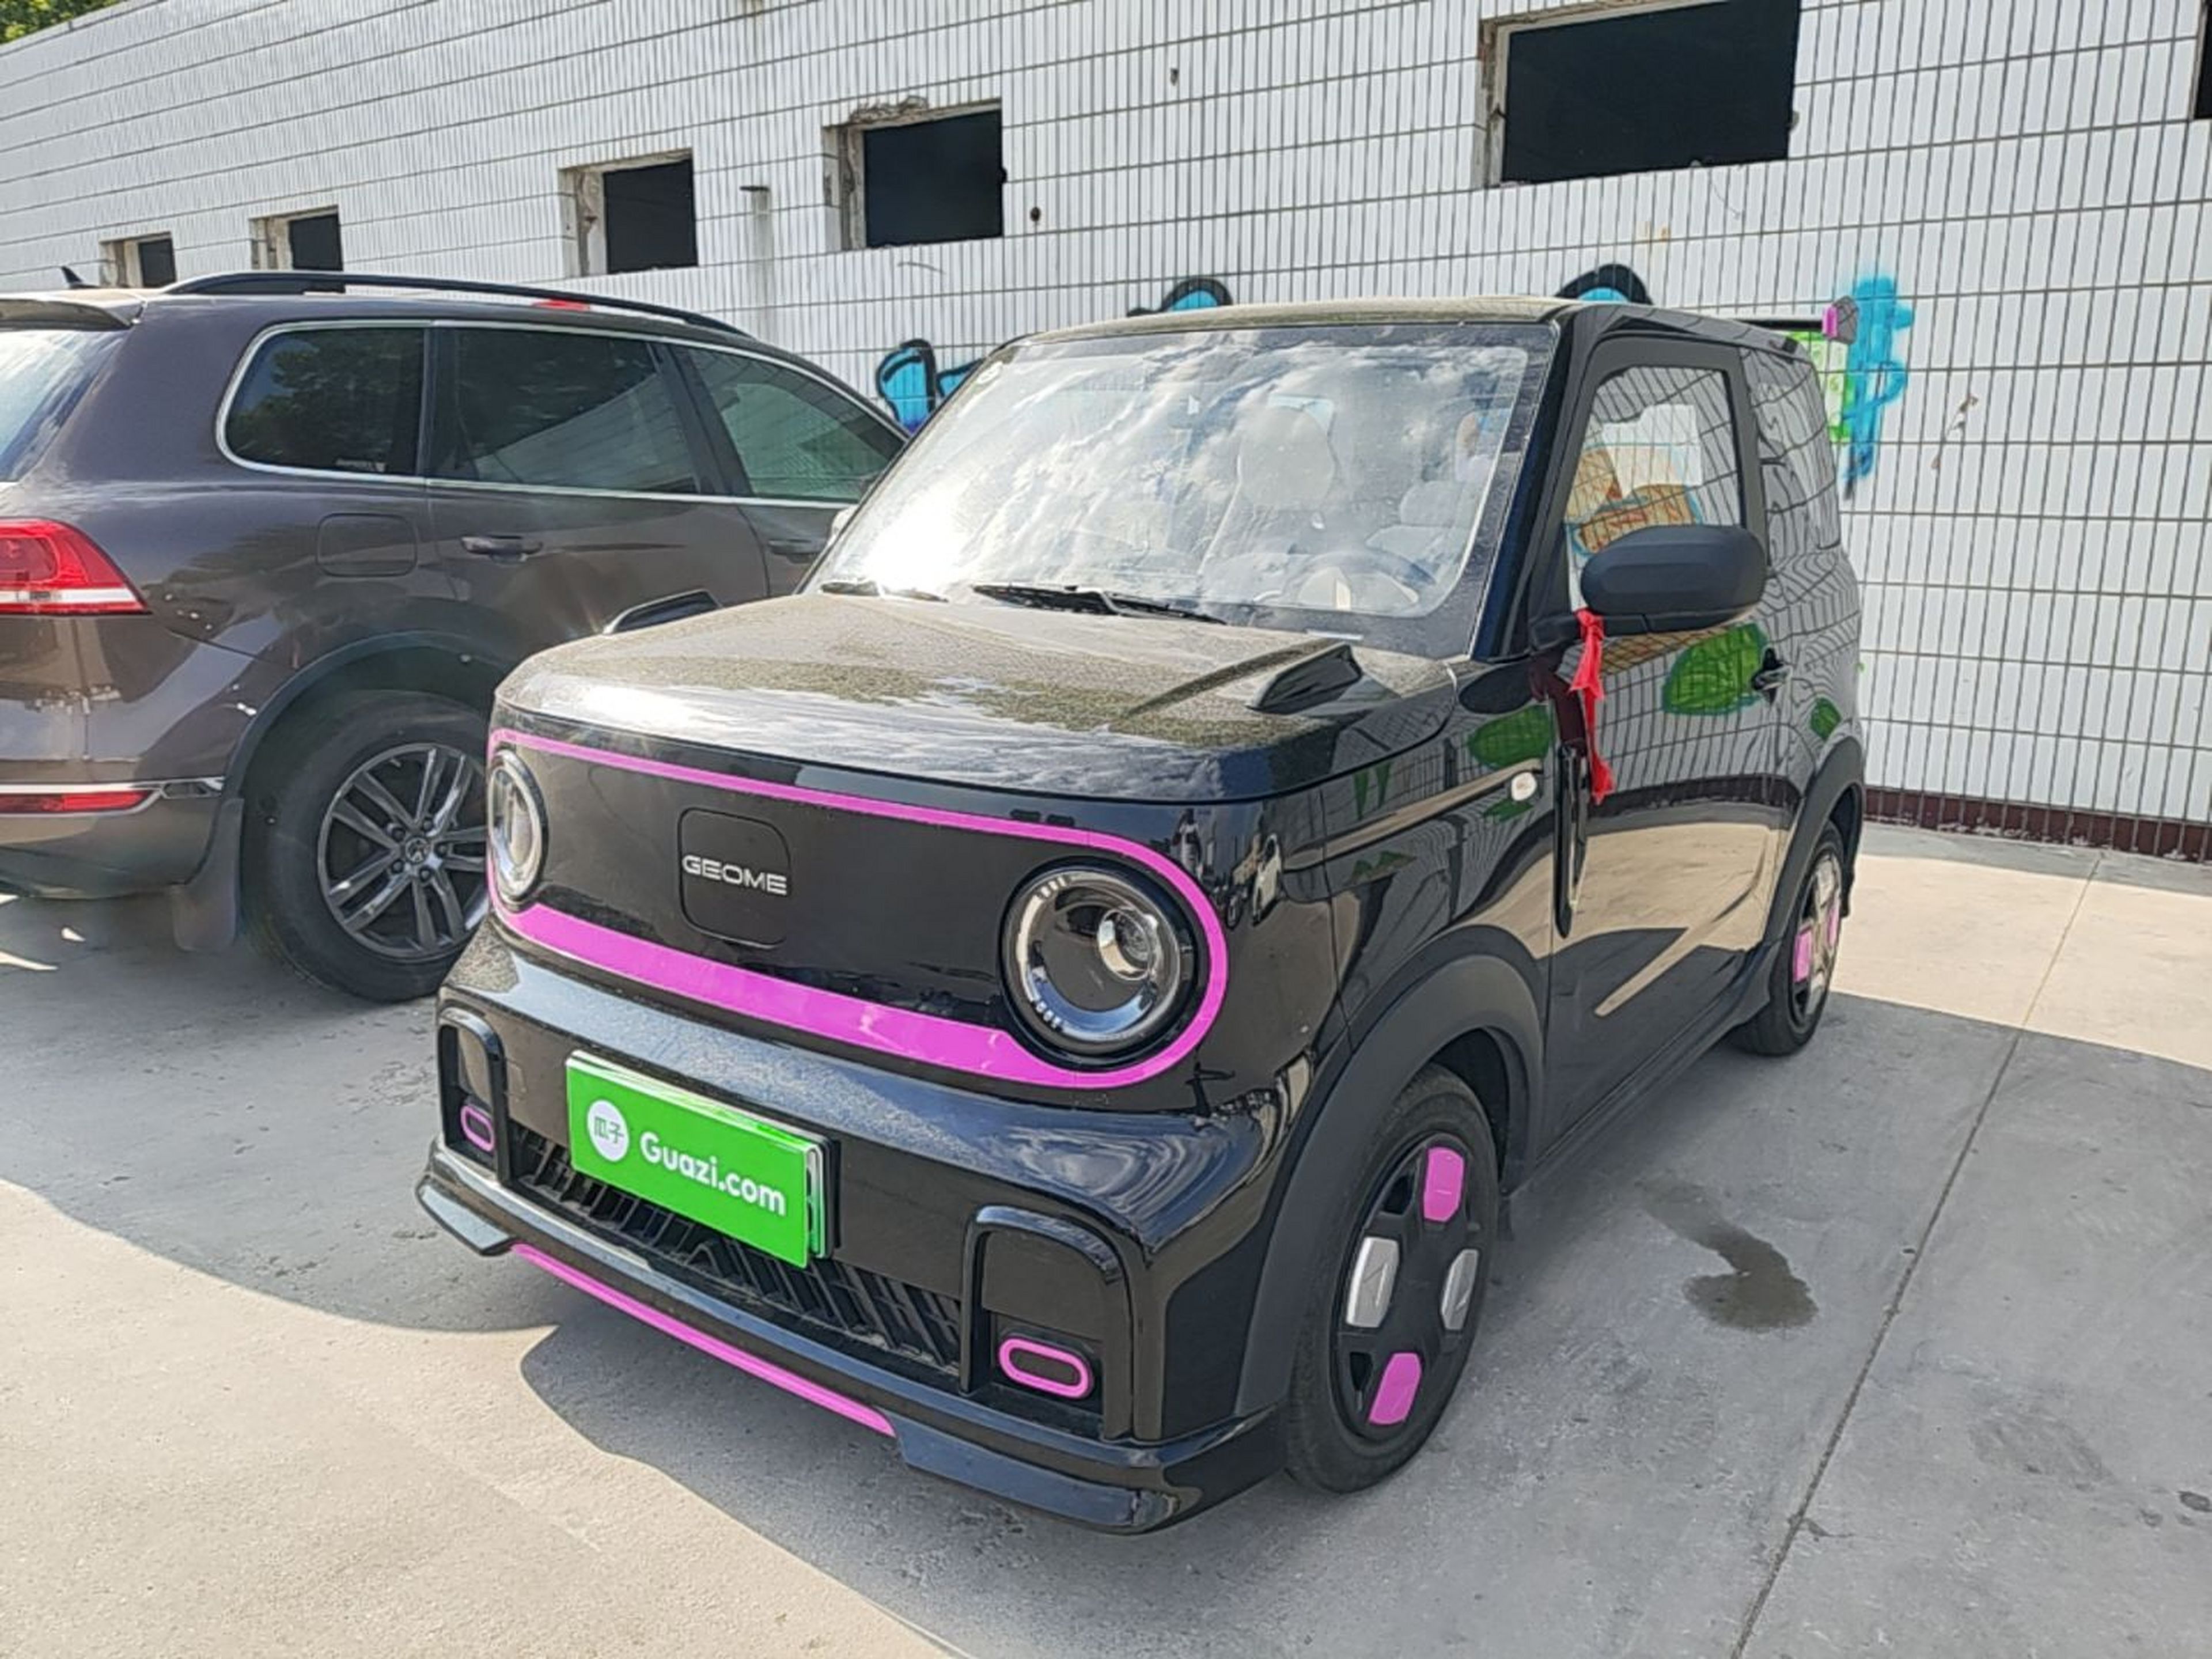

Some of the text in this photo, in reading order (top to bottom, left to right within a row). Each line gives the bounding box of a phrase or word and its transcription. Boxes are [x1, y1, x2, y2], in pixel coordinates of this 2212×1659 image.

[682, 854, 787, 896] GEOME
[594, 1116, 624, 1144] 瓜子
[640, 1131, 786, 1217] Guazi.com
